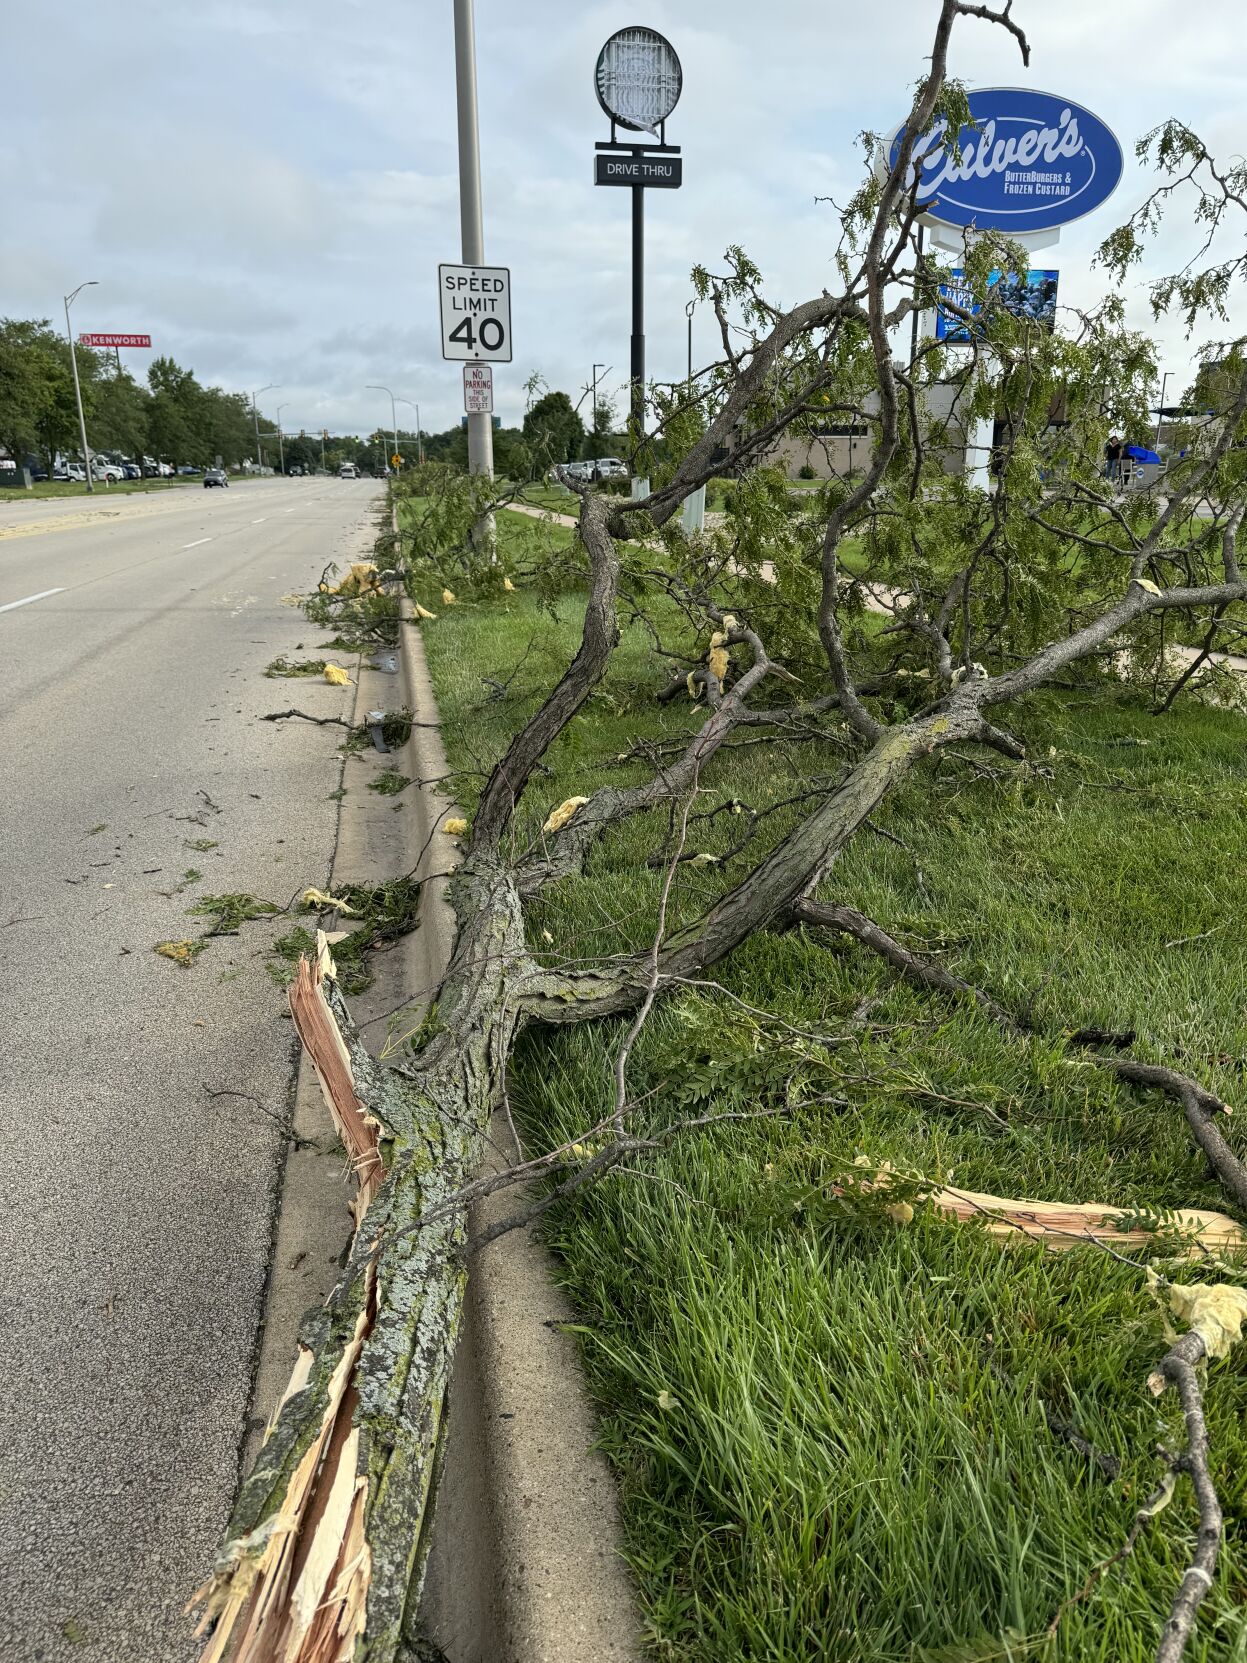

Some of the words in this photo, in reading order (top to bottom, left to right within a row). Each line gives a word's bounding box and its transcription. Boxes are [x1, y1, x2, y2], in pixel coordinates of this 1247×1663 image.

[905, 108, 1084, 199] Culver's
[607, 163, 639, 175] DRIVE
[641, 165, 672, 177] THRU
[1004, 170, 1063, 184] BUTTERBURGERS
[1064, 172, 1072, 184] &
[1003, 182, 1034, 195] FROZEN
[1035, 183, 1071, 196] CUSTARD
[445, 275, 504, 293] SPEED
[452, 296, 498, 312] LIMIT
[92, 335, 149, 345] KENWORTH
[448, 316, 505, 351] 40
[472, 370, 483, 380] NO
[465, 380, 491, 390] PARKING
